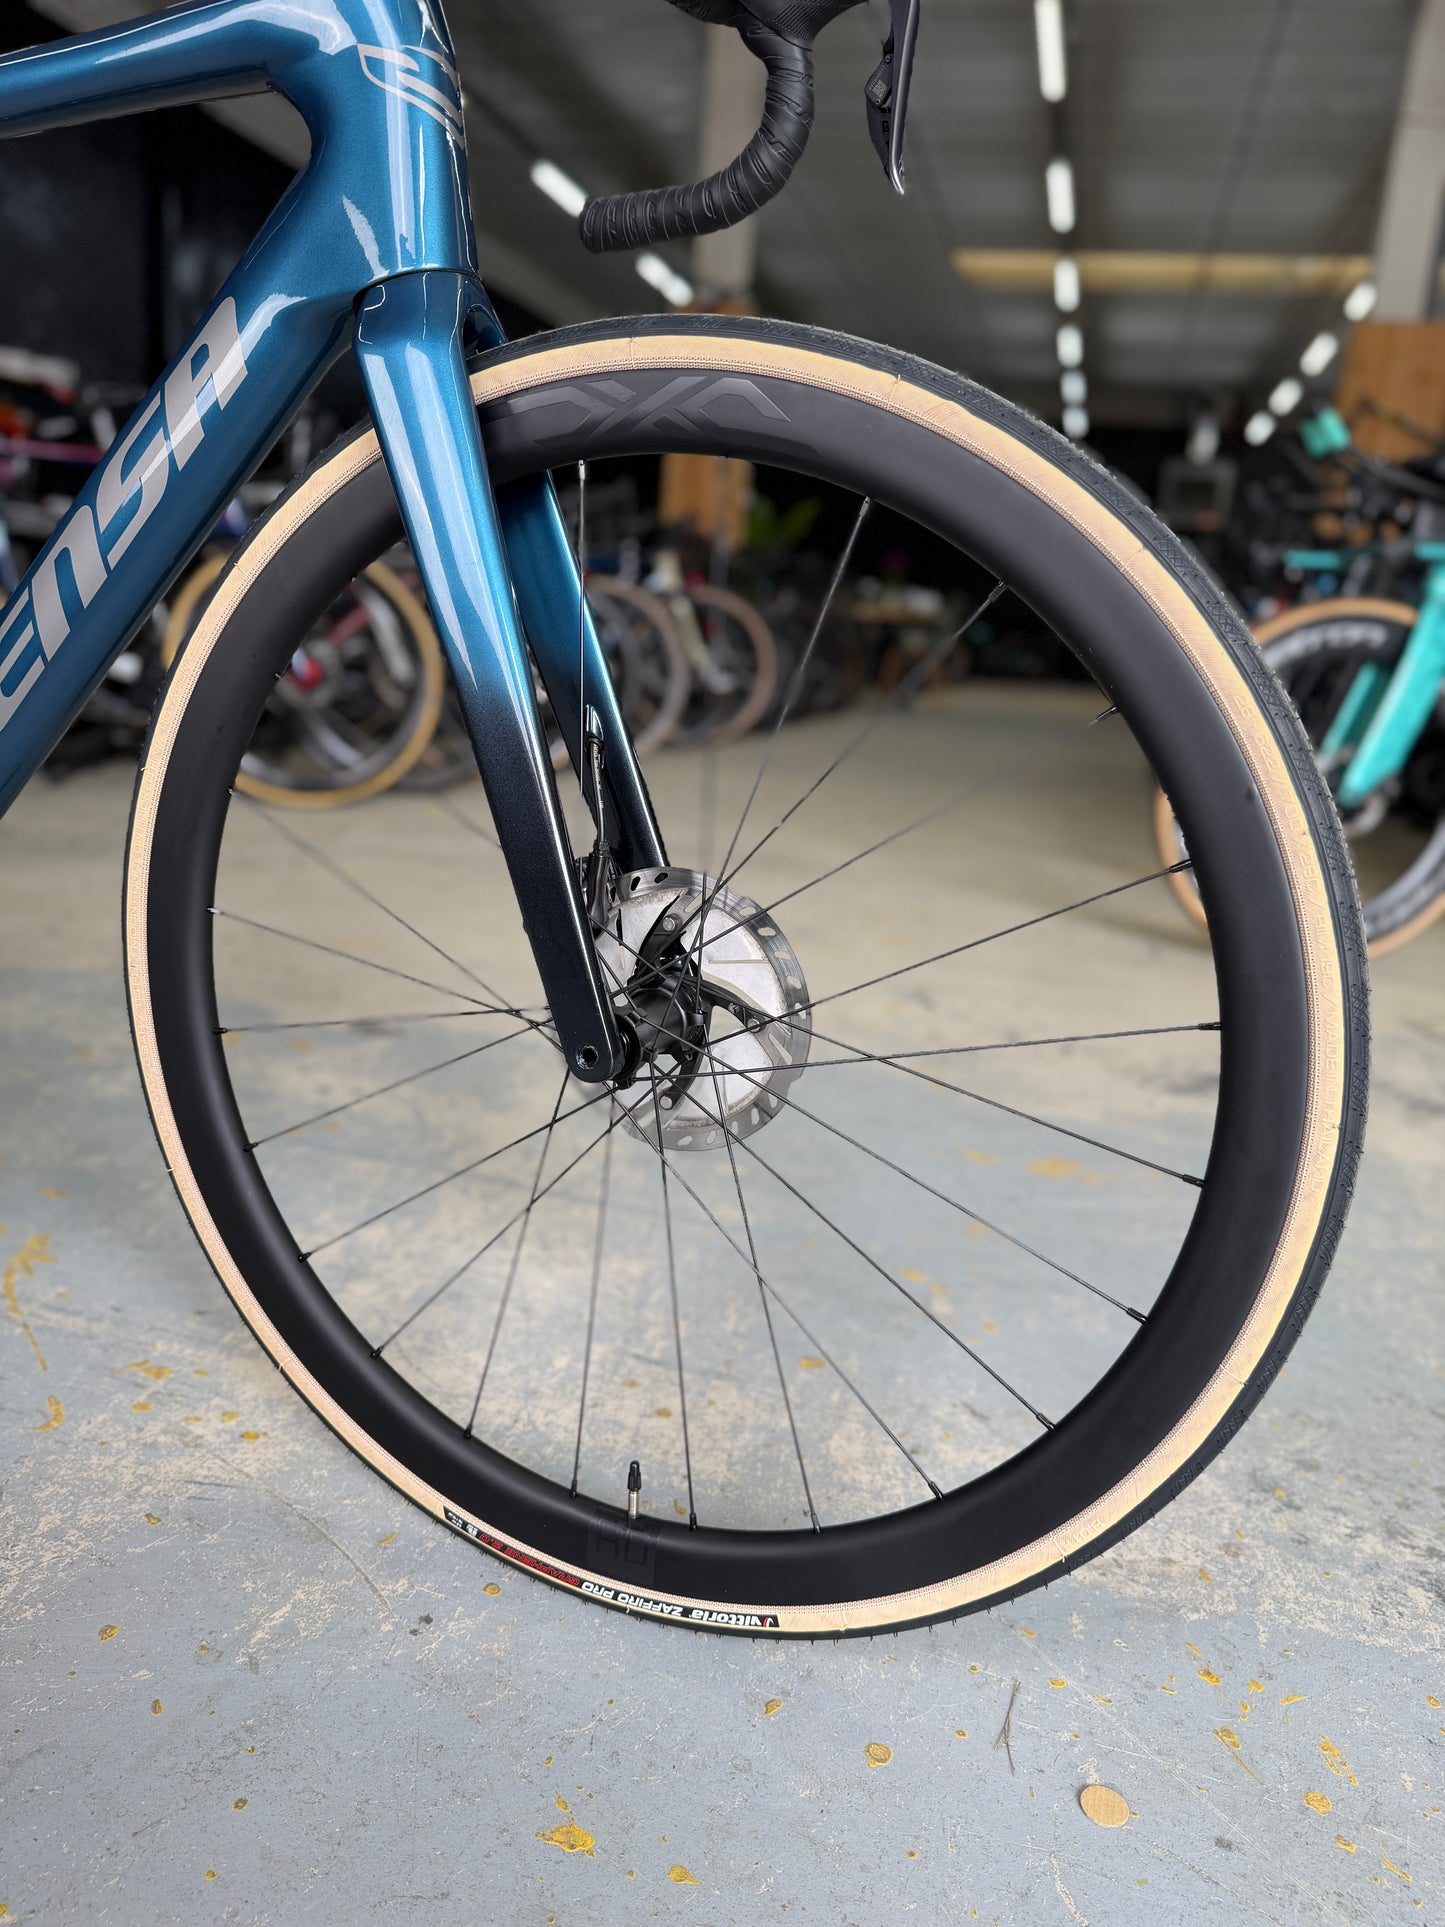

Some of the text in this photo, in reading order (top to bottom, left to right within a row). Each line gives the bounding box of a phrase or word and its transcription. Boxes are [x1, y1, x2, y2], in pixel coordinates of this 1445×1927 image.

[1324, 1008, 1338, 1073] MADE
[1308, 1090, 1337, 1194] THAILAND
[478, 1533, 503, 1551] 2.0
[504, 1546, 580, 1587] GRAPHENE
[581, 1581, 615, 1599] PRO
[617, 1592, 684, 1617] ZAFFIRO
